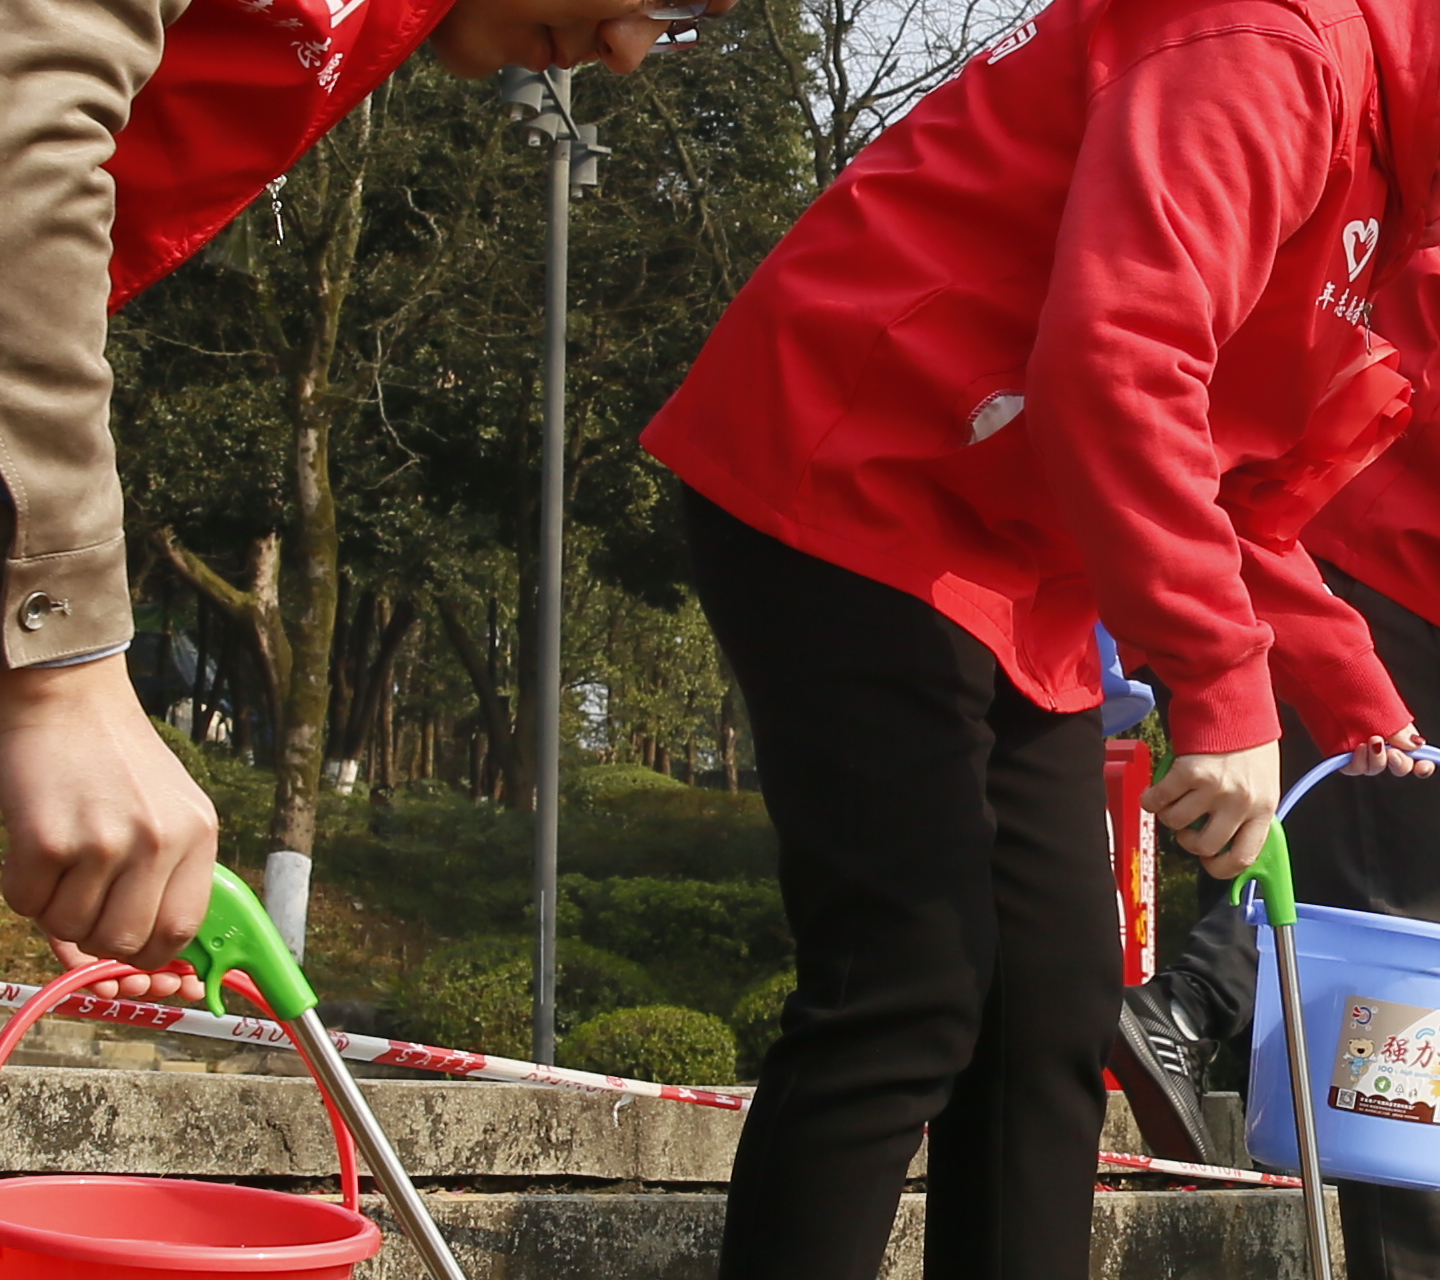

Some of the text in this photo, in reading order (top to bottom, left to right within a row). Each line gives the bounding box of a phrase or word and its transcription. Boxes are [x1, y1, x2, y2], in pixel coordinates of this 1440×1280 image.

[78, 996, 174, 1026] SAFE
[231, 1019, 350, 1053] CAUN
[395, 1048, 477, 1073] SAFE
